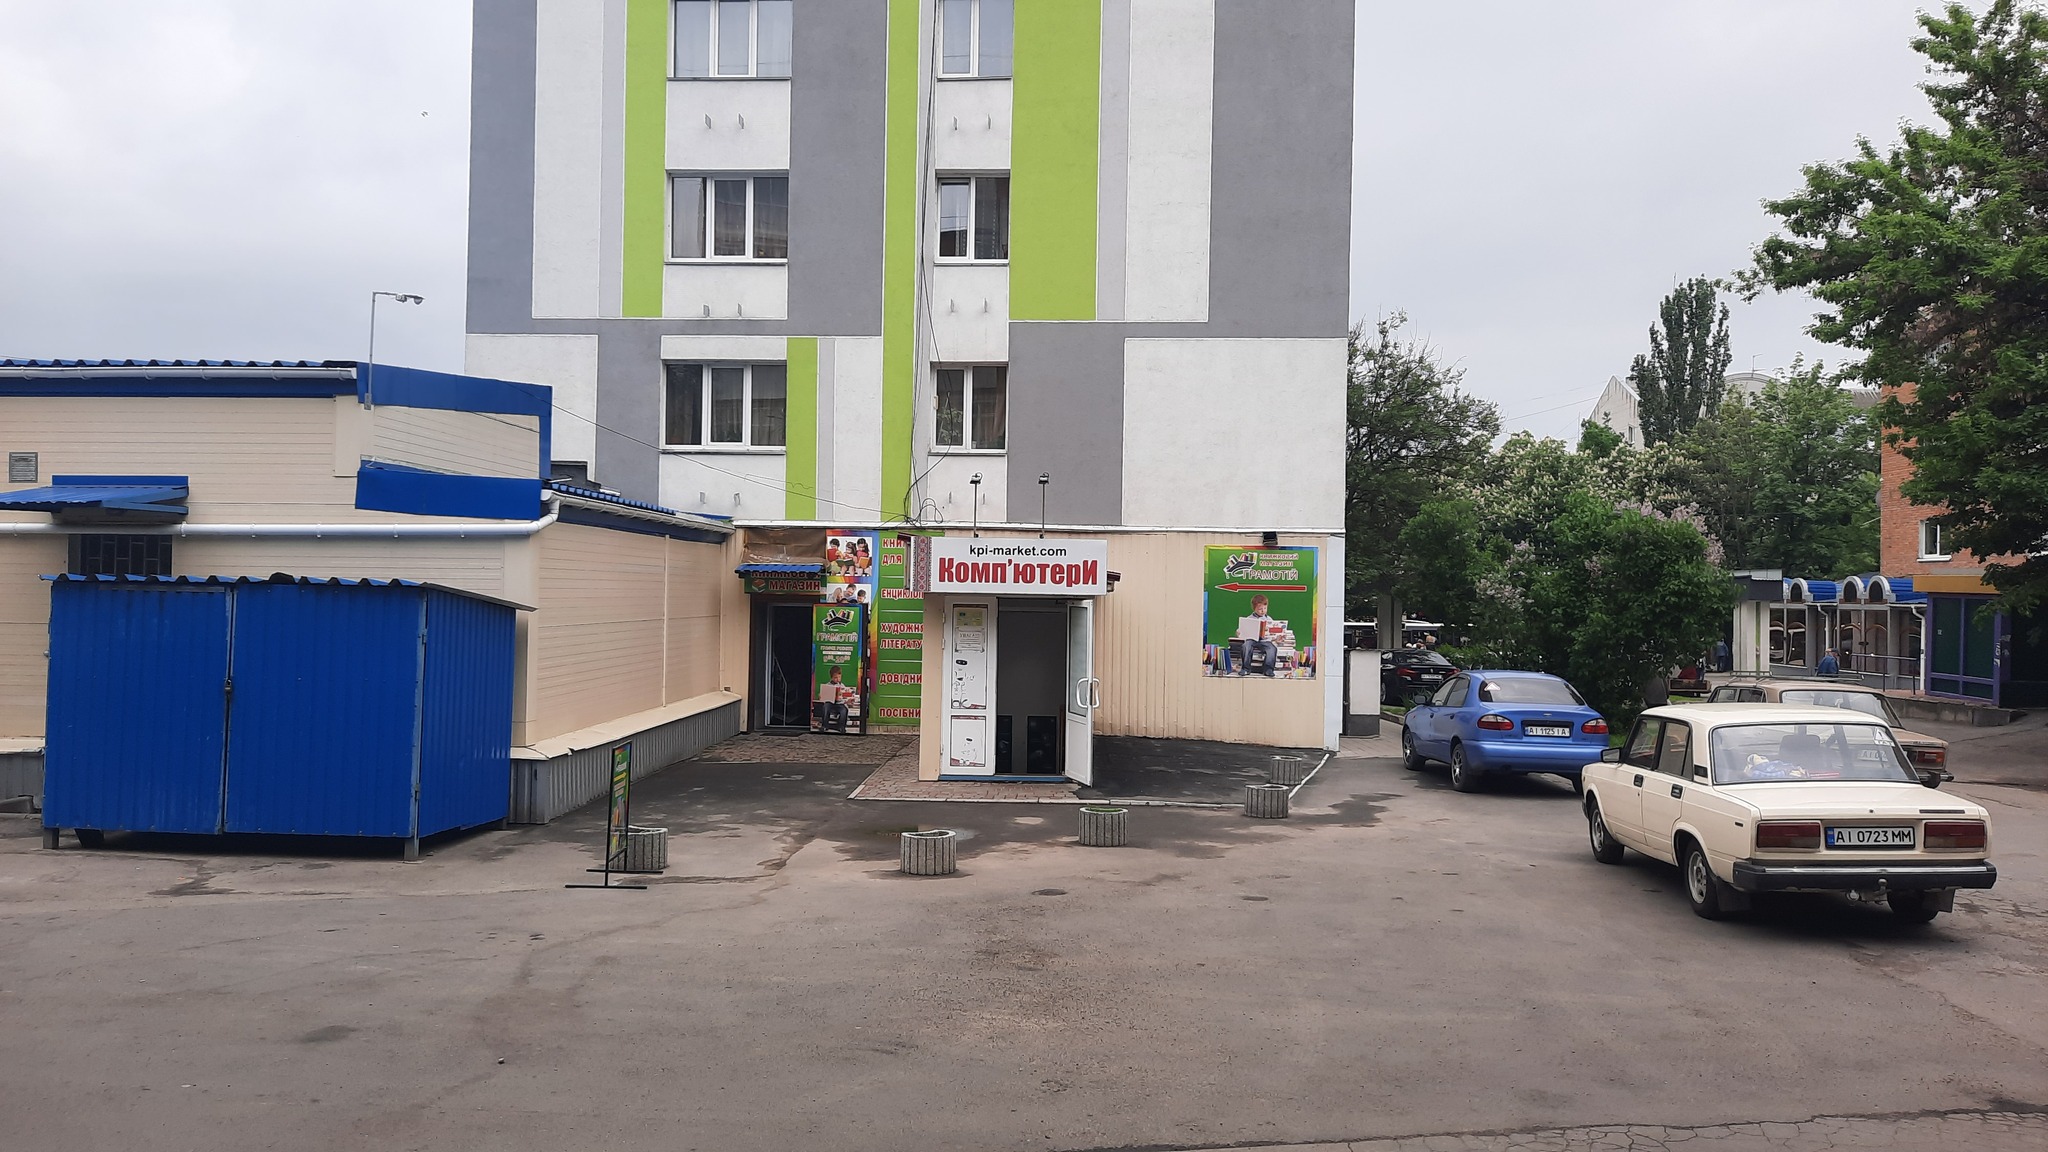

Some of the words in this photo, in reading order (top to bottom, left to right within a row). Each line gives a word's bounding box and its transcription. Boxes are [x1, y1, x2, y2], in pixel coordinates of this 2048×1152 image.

[882, 538, 905, 549] КНИ
[969, 544, 1067, 557] kpi-market.com
[881, 554, 903, 566] ДЛЯ
[938, 557, 1098, 587] Комп'ютерИ
[1242, 568, 1299, 580] ГРАМОТІЙ
[769, 580, 821, 591] МАГАЗИН
[880, 639, 922, 649] ЛІТЕРАТУ
[880, 674, 922, 685] ДОВІДНИ
[879, 708, 920, 718] ПОСІБНИ
[1857, 830, 1889, 843] 0723
[1891, 830, 1911, 843] MM
